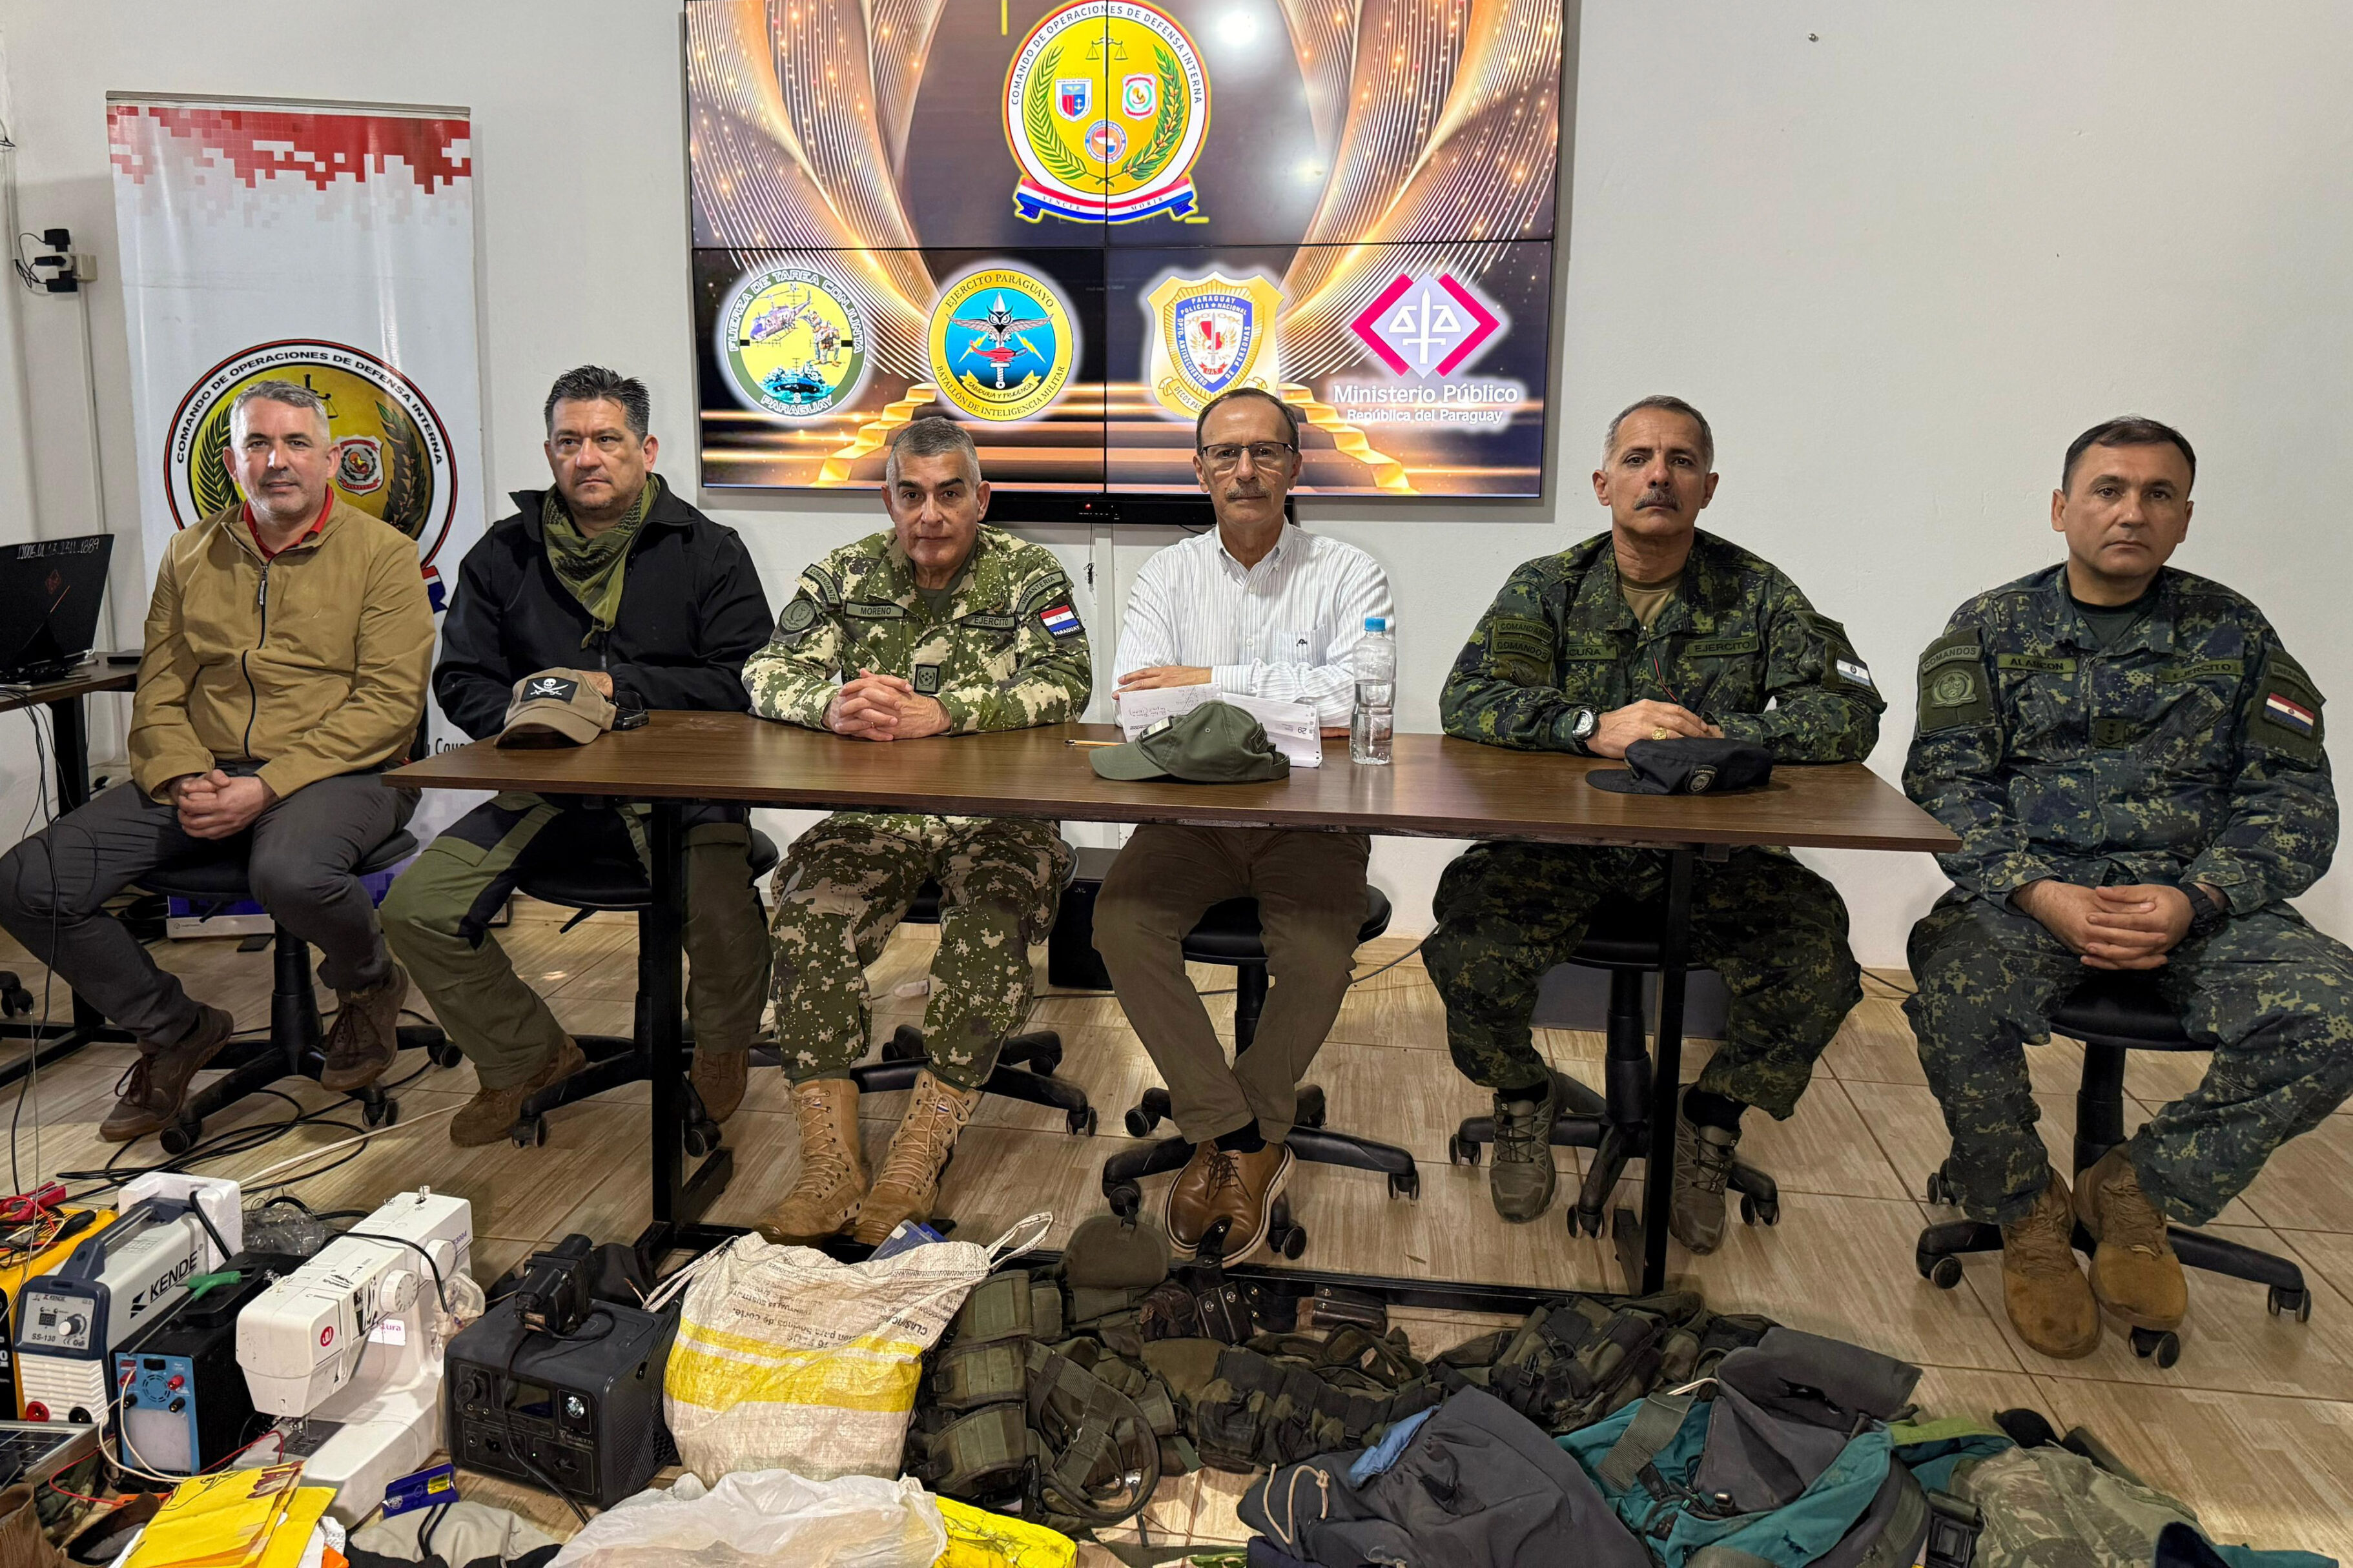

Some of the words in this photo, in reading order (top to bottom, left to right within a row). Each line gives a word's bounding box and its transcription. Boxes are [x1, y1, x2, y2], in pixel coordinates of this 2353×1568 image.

[1011, 48, 1034, 105] COMANDO
[1033, 34, 1046, 48] DE
[1046, 5, 1122, 34] OPERACIONES
[1127, 7, 1141, 20] DE
[1143, 14, 1184, 52] DEFENSA
[1183, 52, 1202, 105] INTERNA
[1042, 195, 1080, 211] VENCER
[1131, 196, 1164, 211] MORIR
[945, 274, 992, 309] EJERCITO
[996, 274, 1054, 308] PARAGUAYO
[1191, 294, 1236, 305] PARAGUAY
[727, 293, 754, 352] FUERZA
[750, 276, 772, 294] DE
[772, 269, 819, 286] TAREA
[821, 280, 864, 354] CONJUNTA
[1180, 302, 1209, 315] POLICIA
[1217, 302, 1248, 315] NACIONAL
[1224, 370, 1235, 381] DE
[1235, 325, 1251, 367] PERSONAS
[1178, 340, 1208, 387] ANTISECUESTRO
[936, 365, 967, 403] BATALLÓN
[967, 400, 980, 412] DE
[980, 397, 1043, 417] INTELIGENCIA
[1043, 365, 1065, 400] MILITAR
[967, 381, 996, 398] SABIDURIA
[1174, 386, 1191, 405] DECOS
[1333, 385, 1436, 405] Ministerio
[1443, 383, 1519, 403] Público
[176, 391, 212, 464] COMANDO
[211, 374, 229, 391] DE
[229, 351, 329, 377] OPERACIONES
[333, 354, 352, 366] DE
[354, 360, 413, 404] DEFENSA
[411, 402, 443, 465] INTERNA
[761, 394, 833, 416] PARAGUAY
[1347, 409, 1411, 423] República
[1415, 409, 1435, 422] del
[1440, 409, 1503, 425] Paraguay
[810, 567, 837, 601] COMANDANTE
[1022, 576, 1056, 605] INFANTERIA
[860, 607, 892, 615] MORENO
[974, 616, 1009, 626] EJERCITO
[1053, 624, 1080, 636] PARAGUAY
[1497, 642, 1548, 660] COMANDOS
[1694, 641, 1751, 652] EJERCITO
[1924, 647, 1977, 669] COMANDOS
[2173, 663, 2232, 678] EJERCITO
[150, 1250, 198, 1301] KENDE
[733, 1307, 761, 1321] corte.
[763, 1316, 774, 1326] de
[32, 1333, 56, 1342] SS-130
